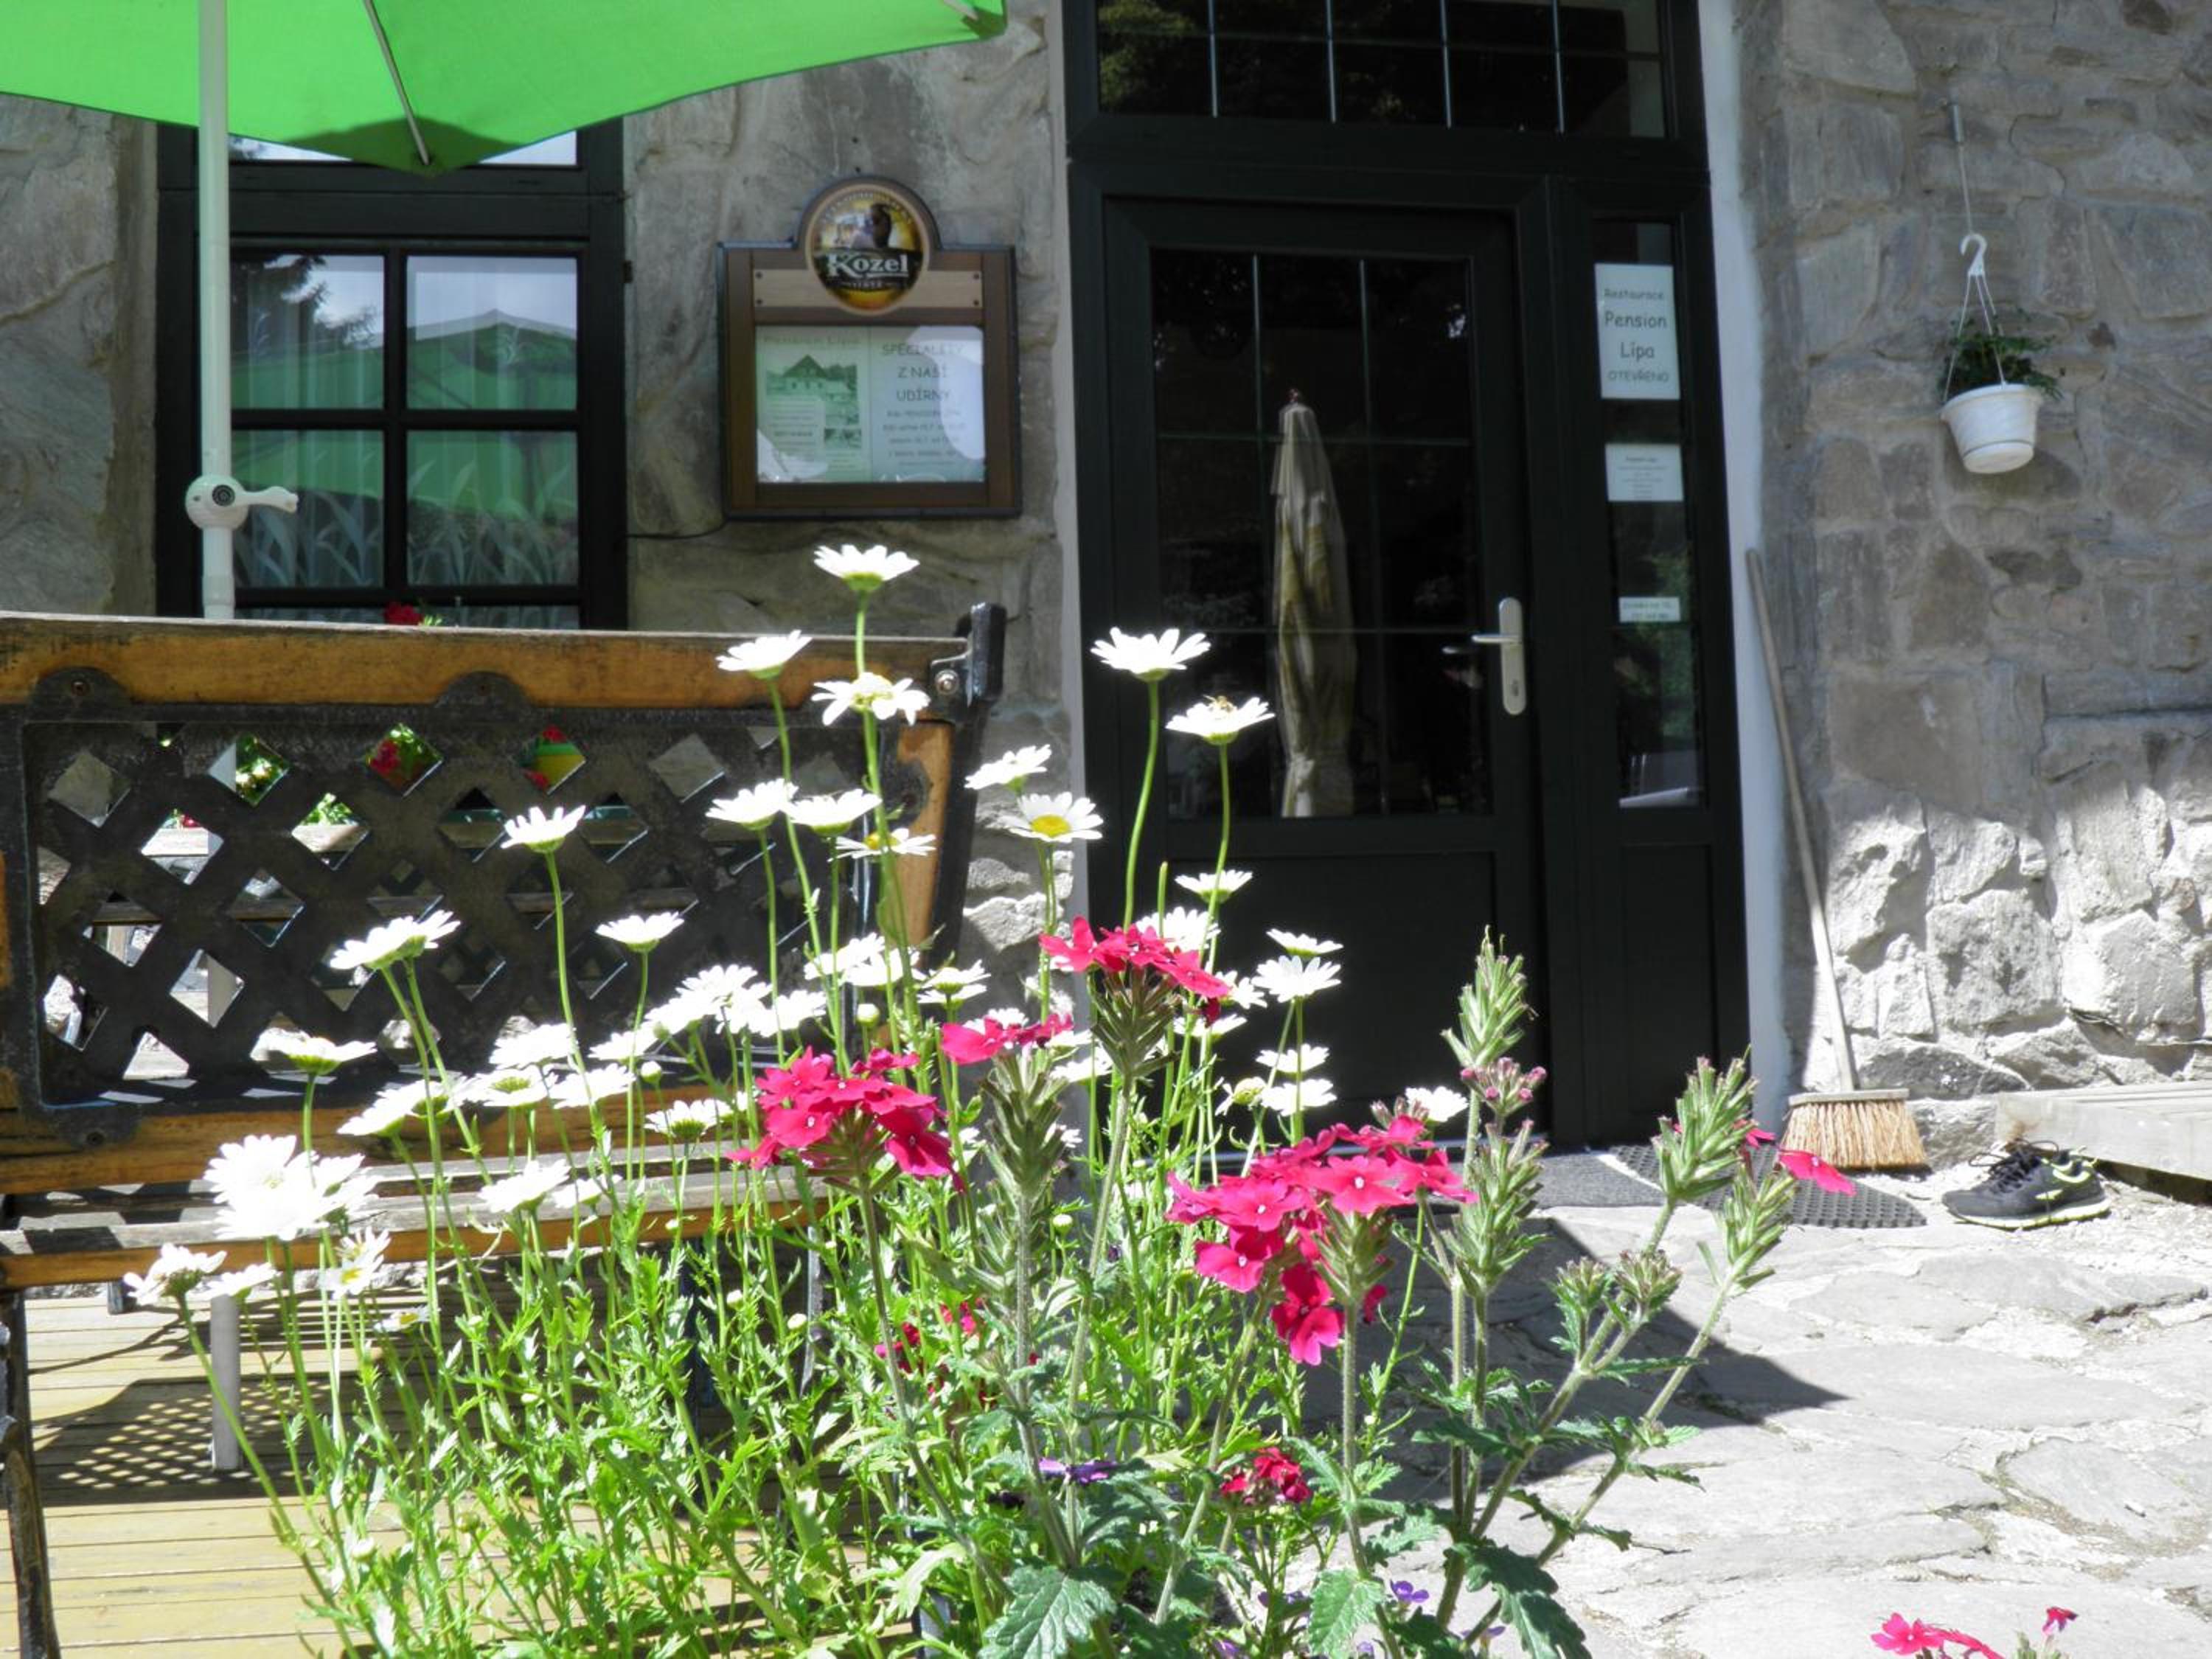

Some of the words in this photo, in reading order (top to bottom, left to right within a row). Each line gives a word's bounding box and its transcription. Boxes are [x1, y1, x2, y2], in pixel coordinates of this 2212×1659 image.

[826, 253, 909, 278] Kozel
[1604, 310, 1667, 328] Pension
[897, 366, 908, 378] Z
